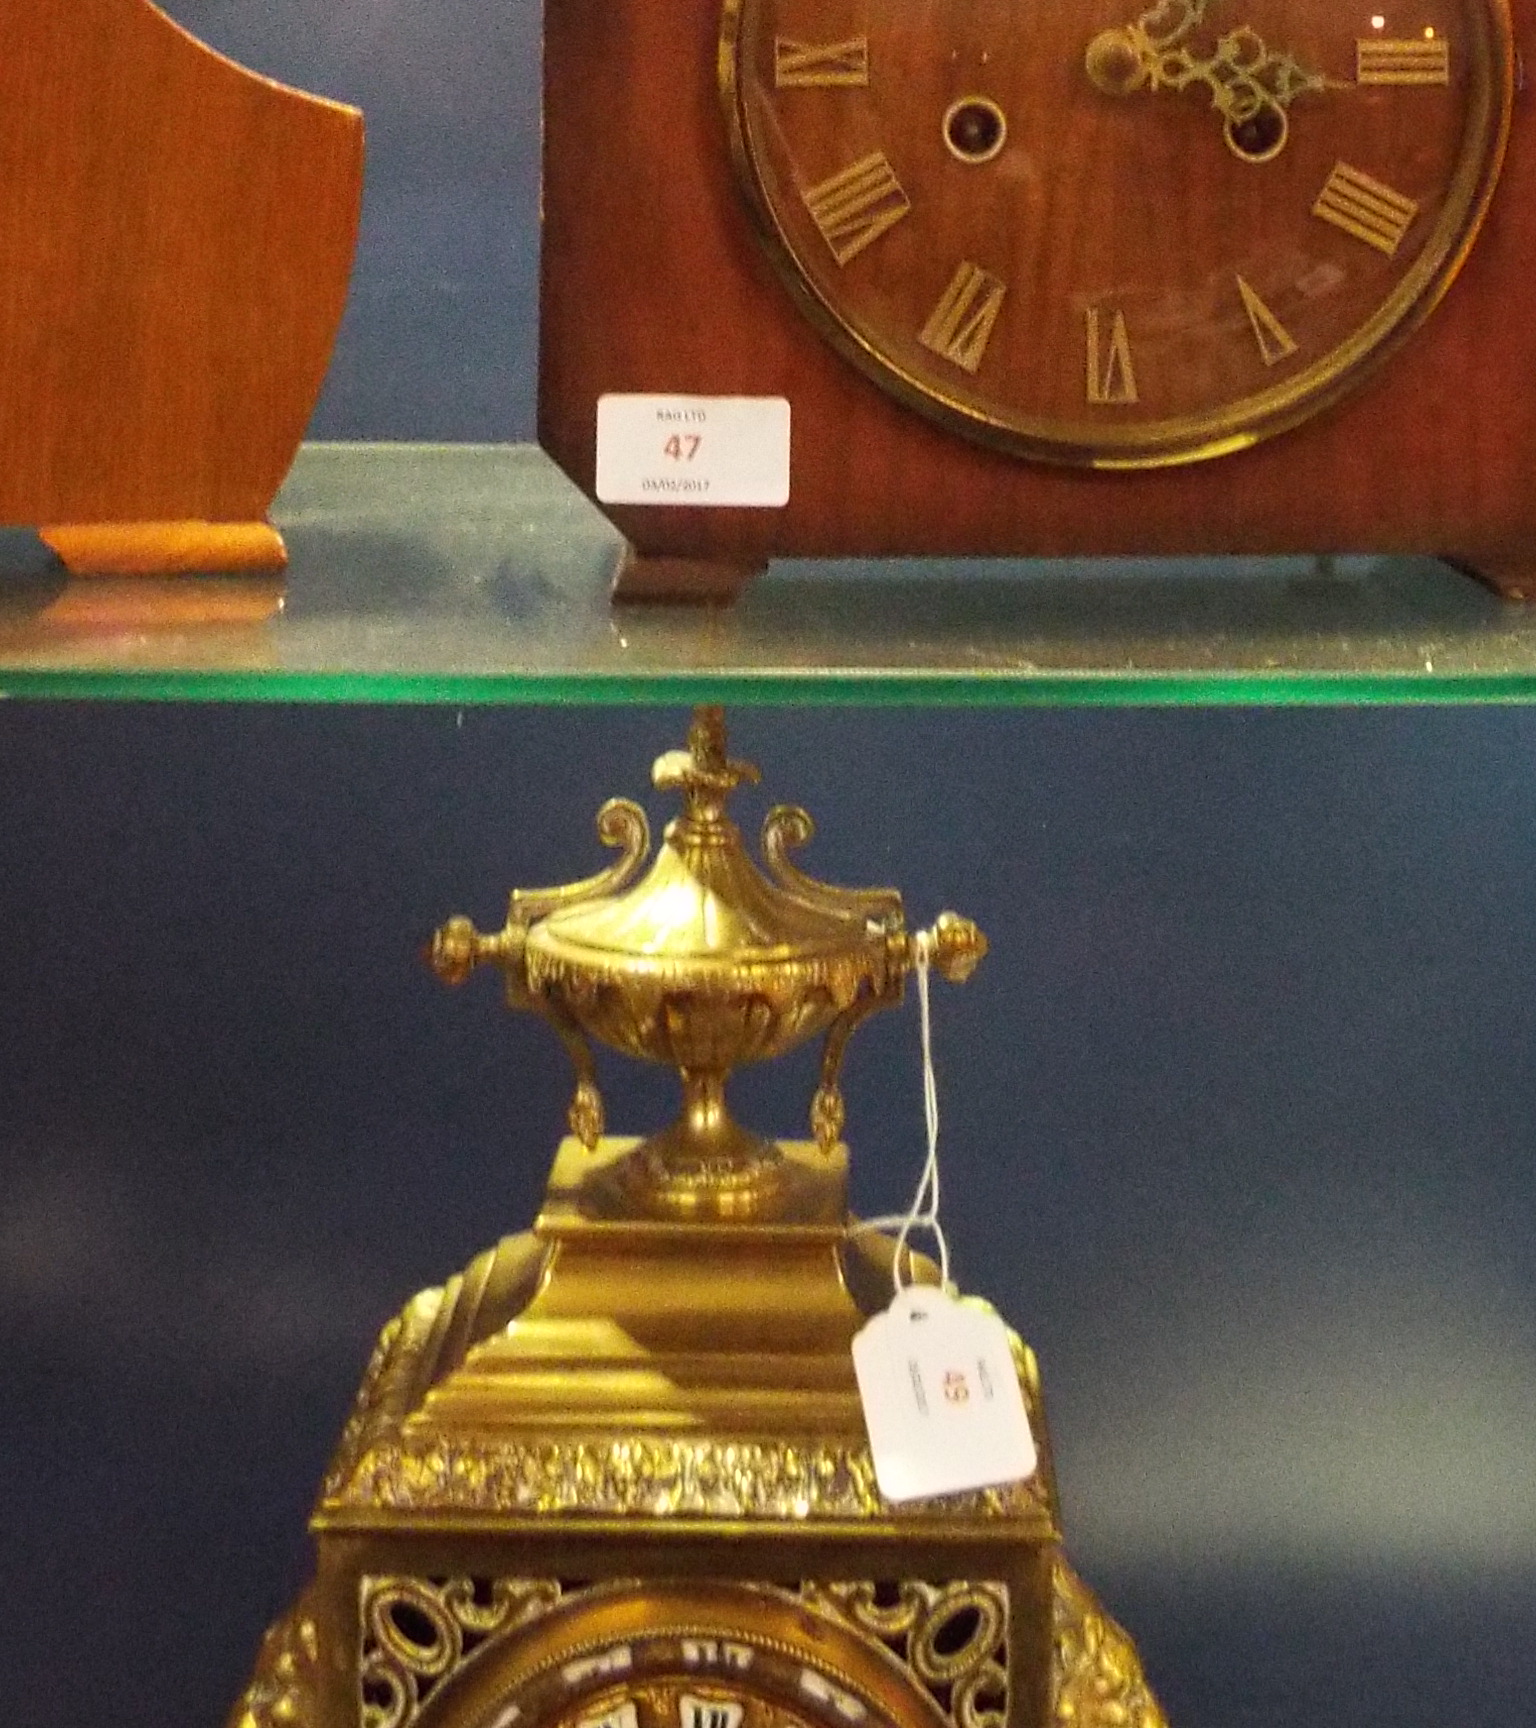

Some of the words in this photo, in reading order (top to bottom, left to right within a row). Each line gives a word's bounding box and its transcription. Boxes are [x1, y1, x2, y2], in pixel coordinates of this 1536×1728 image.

[774, 35, 869, 87] IX
[1356, 37, 1450, 86] III
[803, 151, 912, 268] VIII
[1312, 160, 1420, 258] IIII
[918, 260, 1007, 375] VII
[1085, 307, 1140, 405] VI
[1235, 274, 1299, 367] V
[663, 432, 703, 463] 47
